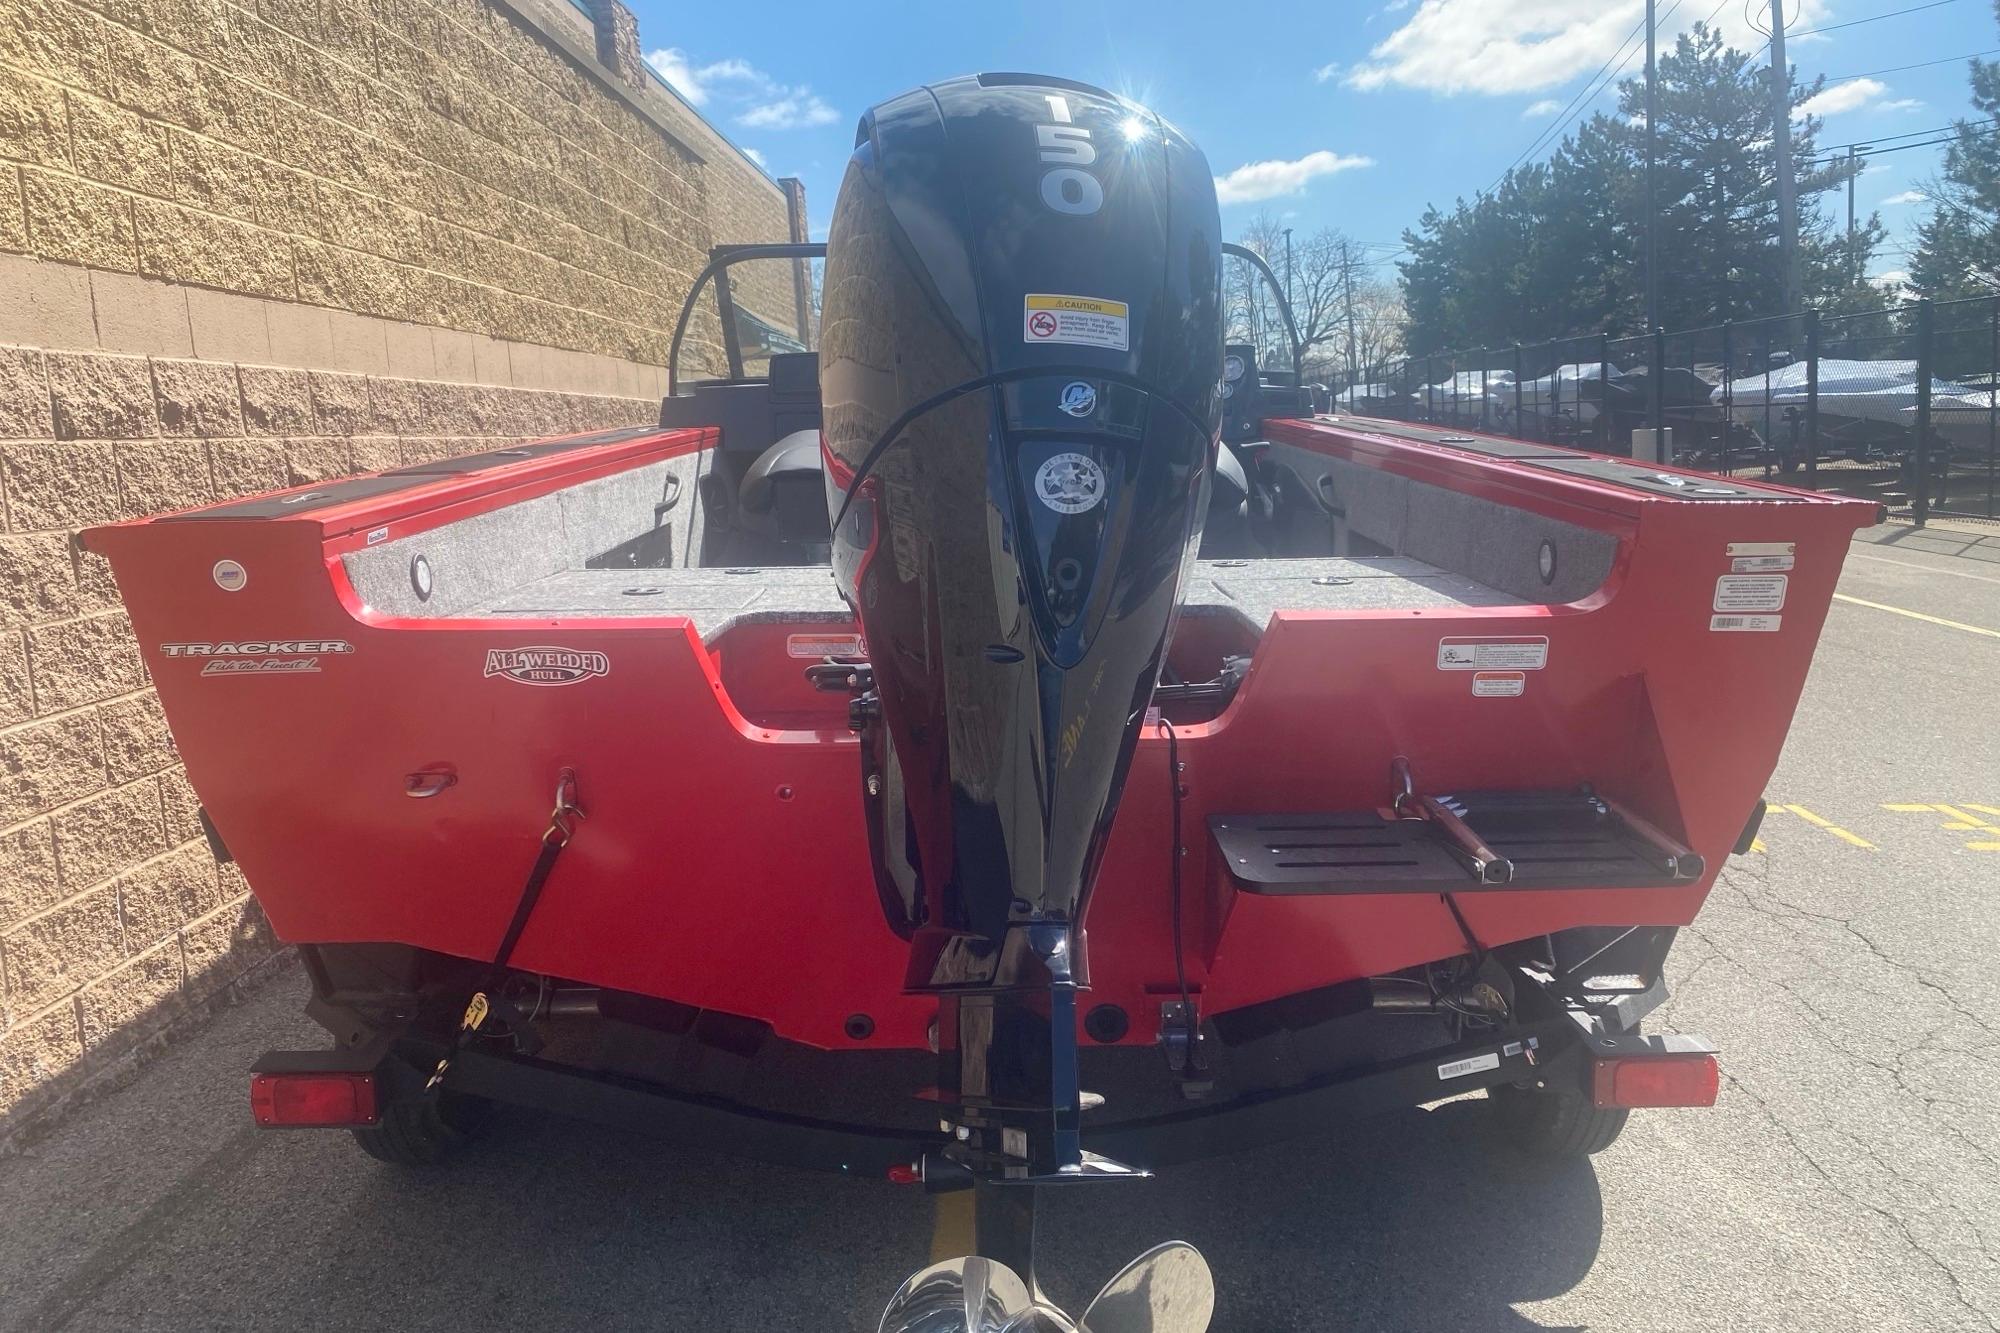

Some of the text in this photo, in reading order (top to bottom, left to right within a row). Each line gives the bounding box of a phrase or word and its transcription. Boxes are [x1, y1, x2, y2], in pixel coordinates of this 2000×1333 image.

[1035, 95, 1104, 215] 150
[1064, 301, 1102, 311] CAUTION
[161, 641, 349, 657] TRACKER
[206, 660, 235, 671] Fish
[238, 661, 258, 670] the
[521, 652, 607, 674] WELDED
[530, 671, 565, 680] HULL
